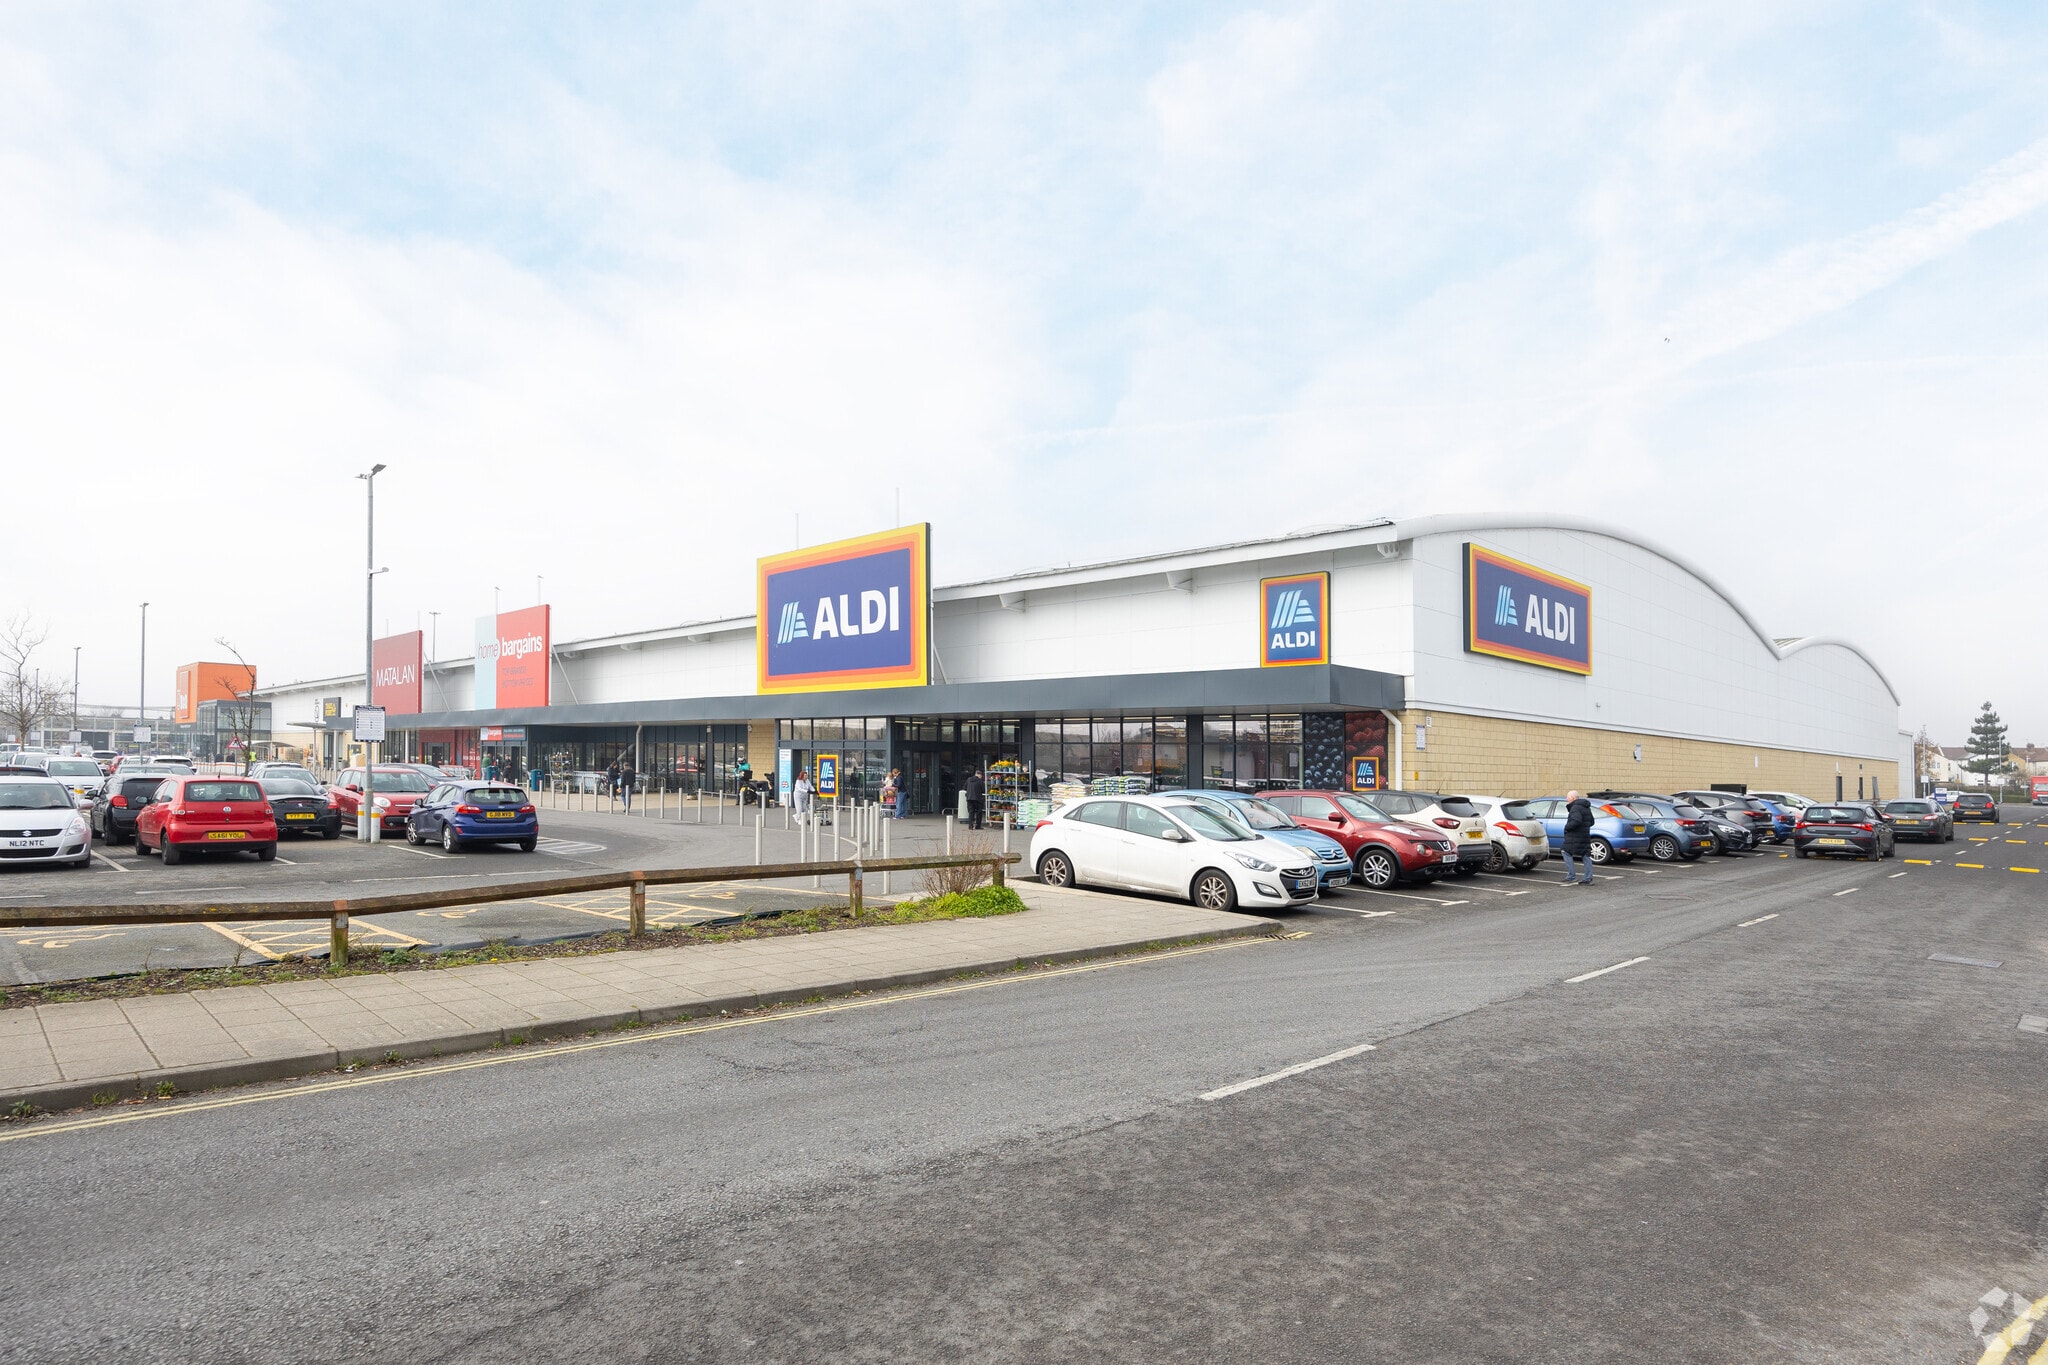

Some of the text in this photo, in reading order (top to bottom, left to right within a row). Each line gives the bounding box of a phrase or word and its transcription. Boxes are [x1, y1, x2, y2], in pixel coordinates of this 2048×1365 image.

[812, 586, 900, 641] ALDI
[1525, 593, 1575, 645] ALDI
[477, 632, 543, 660] home bargains
[1271, 630, 1316, 649] ALDI
[375, 664, 415, 688] MATALAN
[820, 780, 835, 789] ALDI
